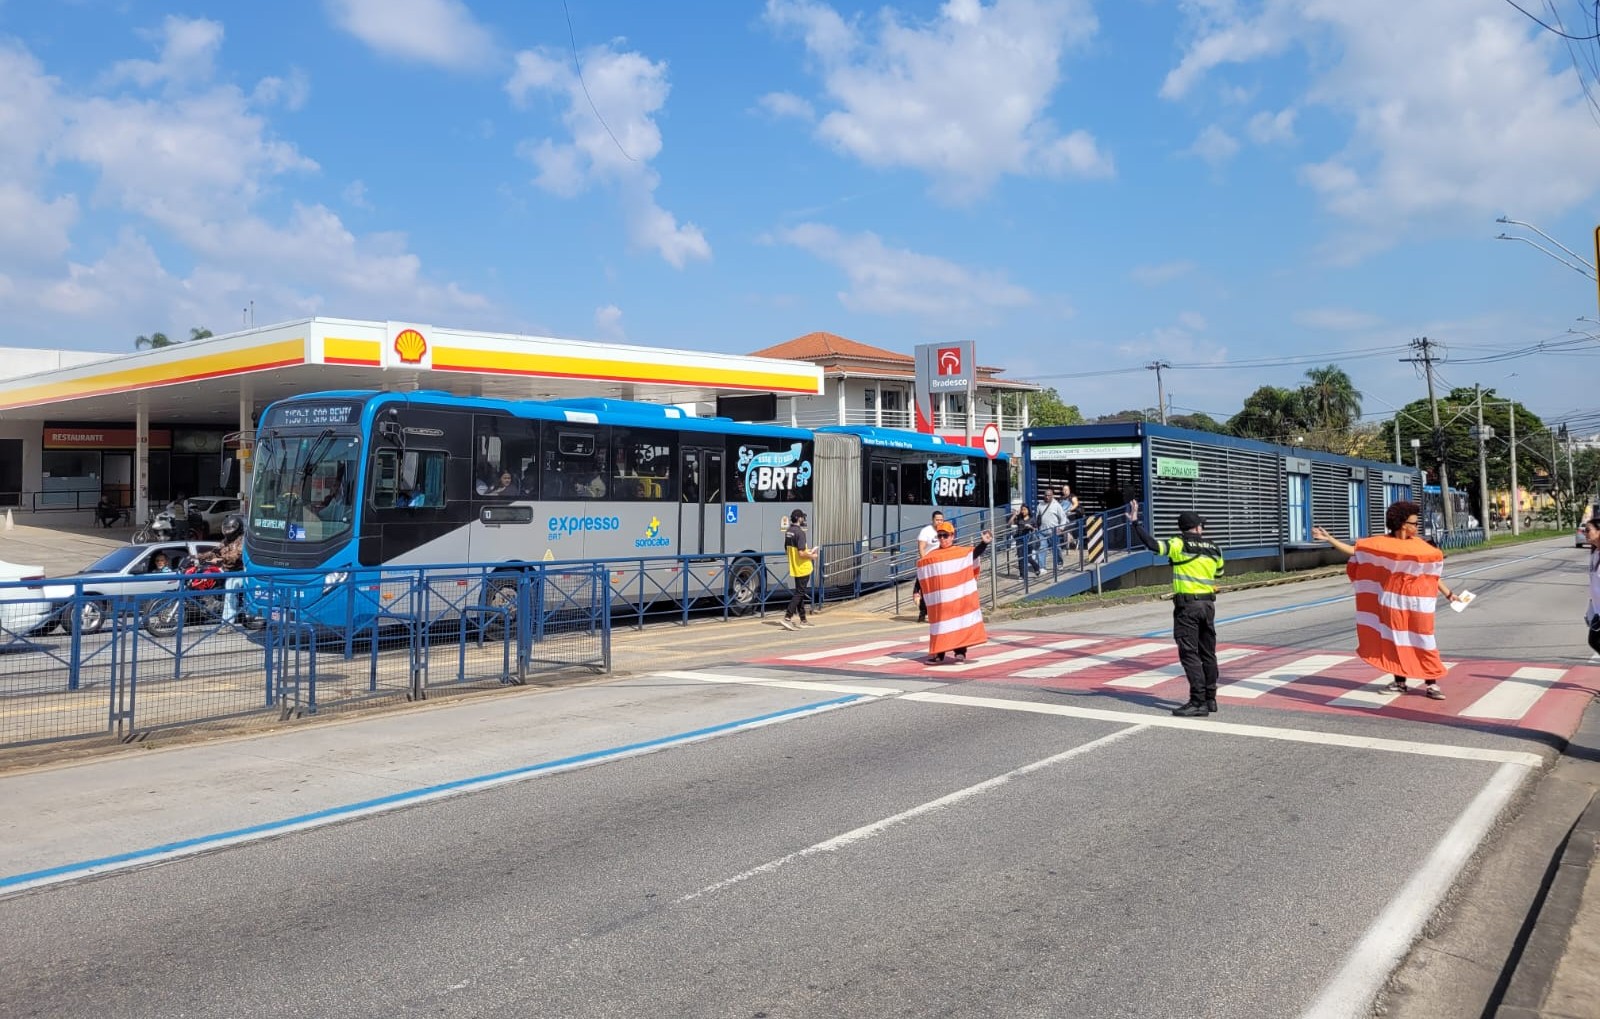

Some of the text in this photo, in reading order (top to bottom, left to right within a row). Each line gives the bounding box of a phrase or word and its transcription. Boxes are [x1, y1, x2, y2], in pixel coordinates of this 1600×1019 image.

[932, 379, 968, 388] Bradesco
[52, 433, 104, 442] RESTAURANTE
[1171, 466, 1183, 476] ZONA
[1184, 467, 1197, 477] NORTE
[758, 467, 797, 490] BRT
[939, 478, 966, 497] BRT
[548, 516, 619, 536] expresso
[635, 537, 669, 547] sorocaba
